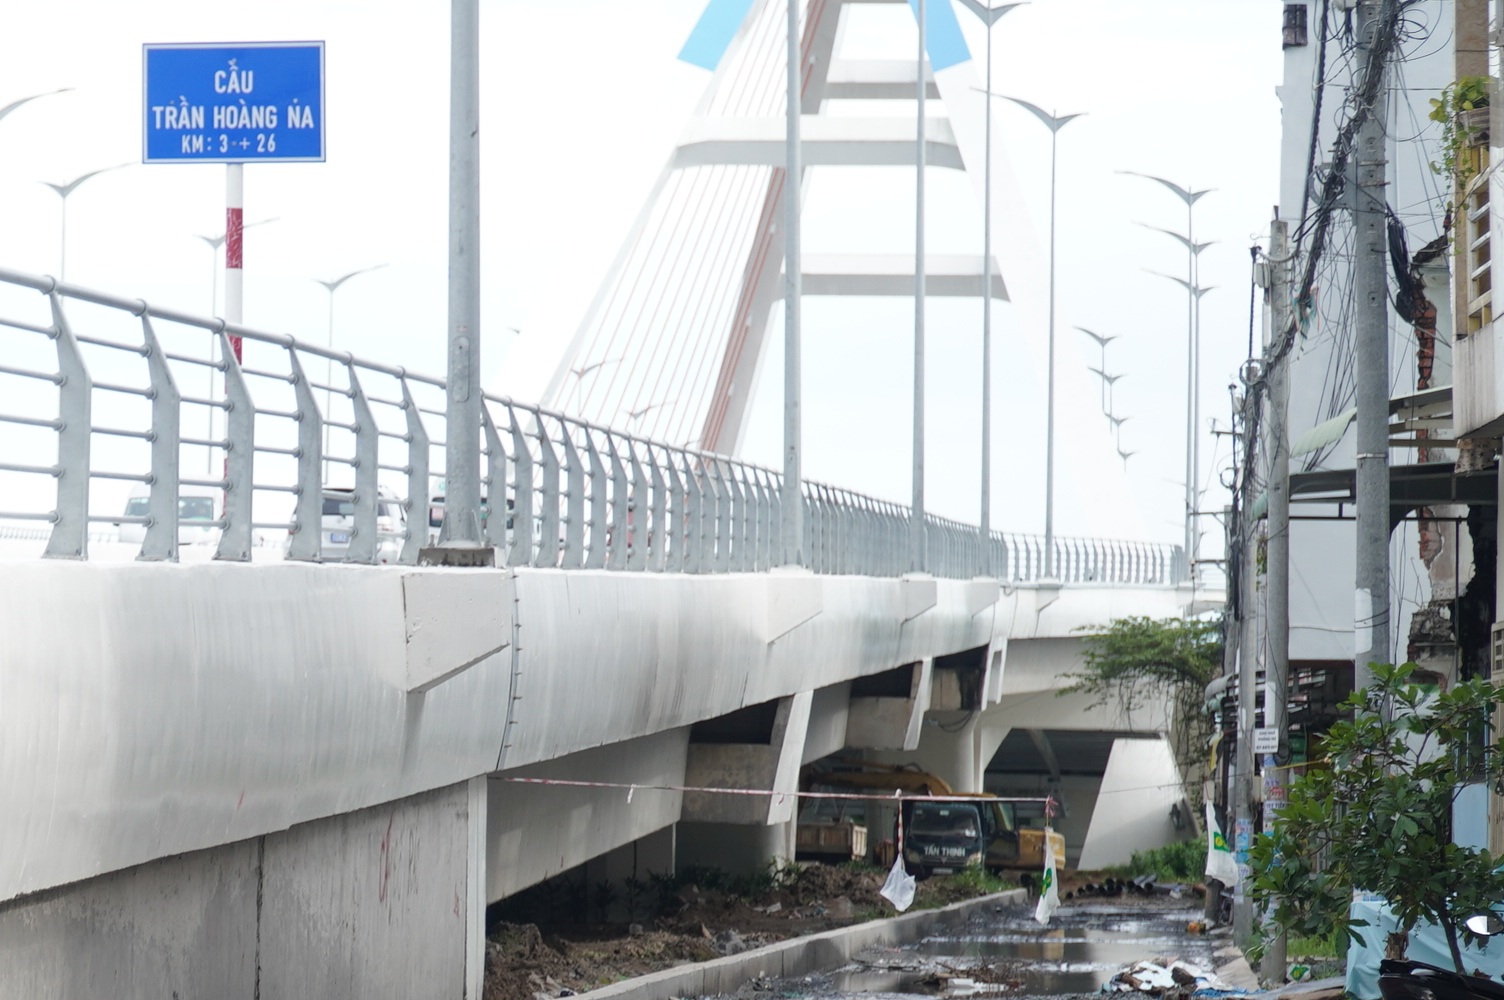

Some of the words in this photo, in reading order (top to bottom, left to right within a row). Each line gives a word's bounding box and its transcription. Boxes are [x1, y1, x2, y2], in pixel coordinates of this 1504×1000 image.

[214, 58, 254, 94] CẦU
[152, 95, 205, 129] TRẦN
[213, 98, 278, 129] HOÀNG
